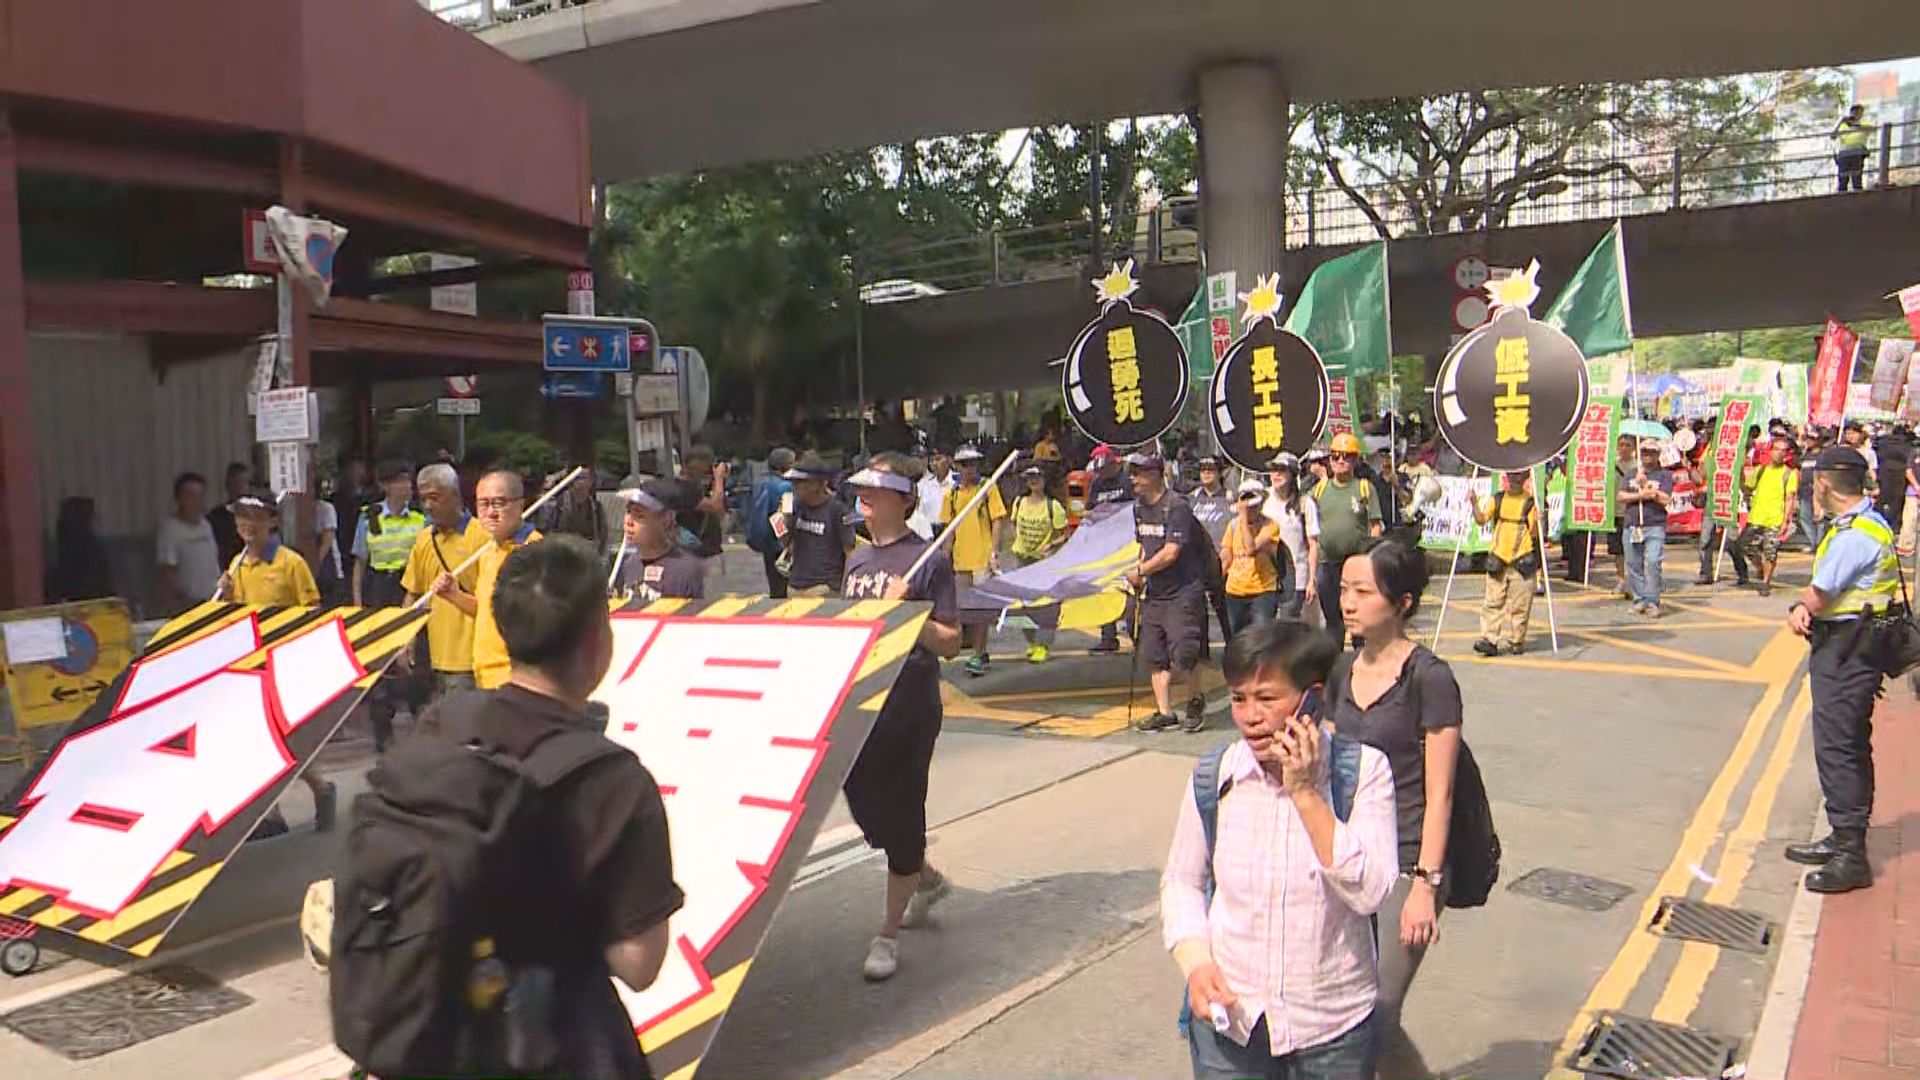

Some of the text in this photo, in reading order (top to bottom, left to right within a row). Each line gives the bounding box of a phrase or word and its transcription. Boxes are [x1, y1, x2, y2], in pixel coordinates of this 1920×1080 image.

[1251, 345, 1284, 450] 長工時
[1494, 336, 1530, 445] 低工資
[1573, 403, 1613, 524] 立法標準工時
